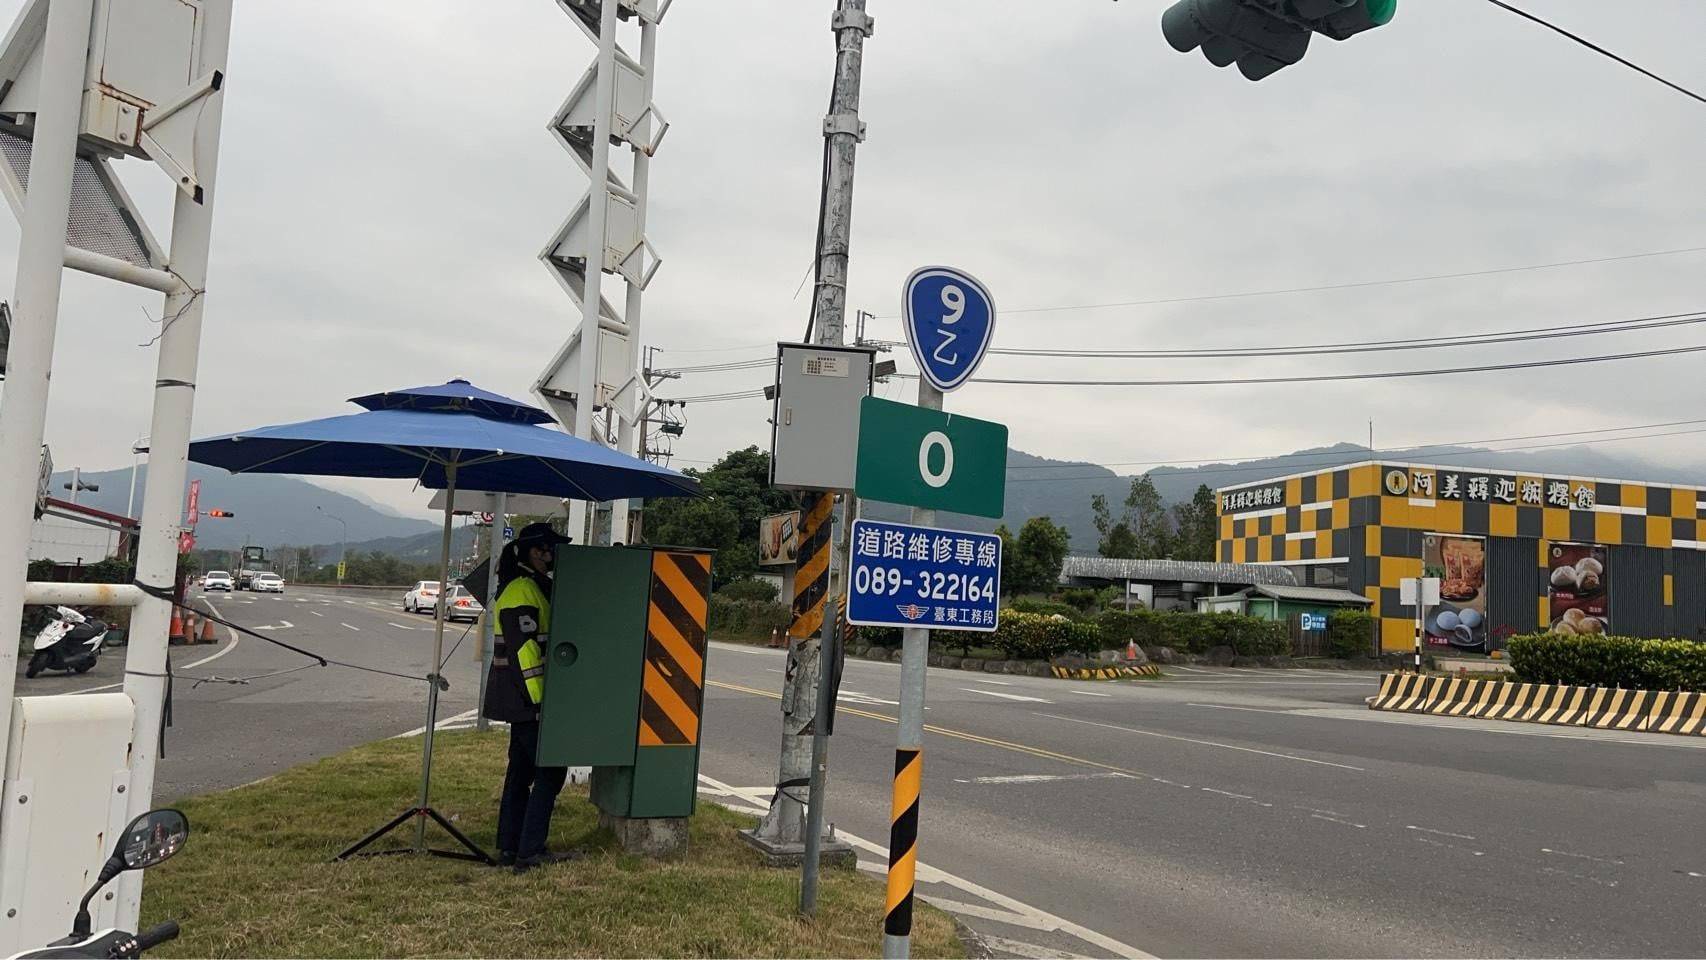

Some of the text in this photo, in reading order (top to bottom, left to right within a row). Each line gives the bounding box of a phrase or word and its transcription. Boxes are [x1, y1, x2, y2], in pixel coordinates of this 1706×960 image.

[940, 284, 967, 324] 9
[933, 329, 957, 366] 乙
[918, 430, 954, 488] 0
[857, 526, 996, 568] 道路維修專線
[934, 606, 994, 625] 臺東工務段
